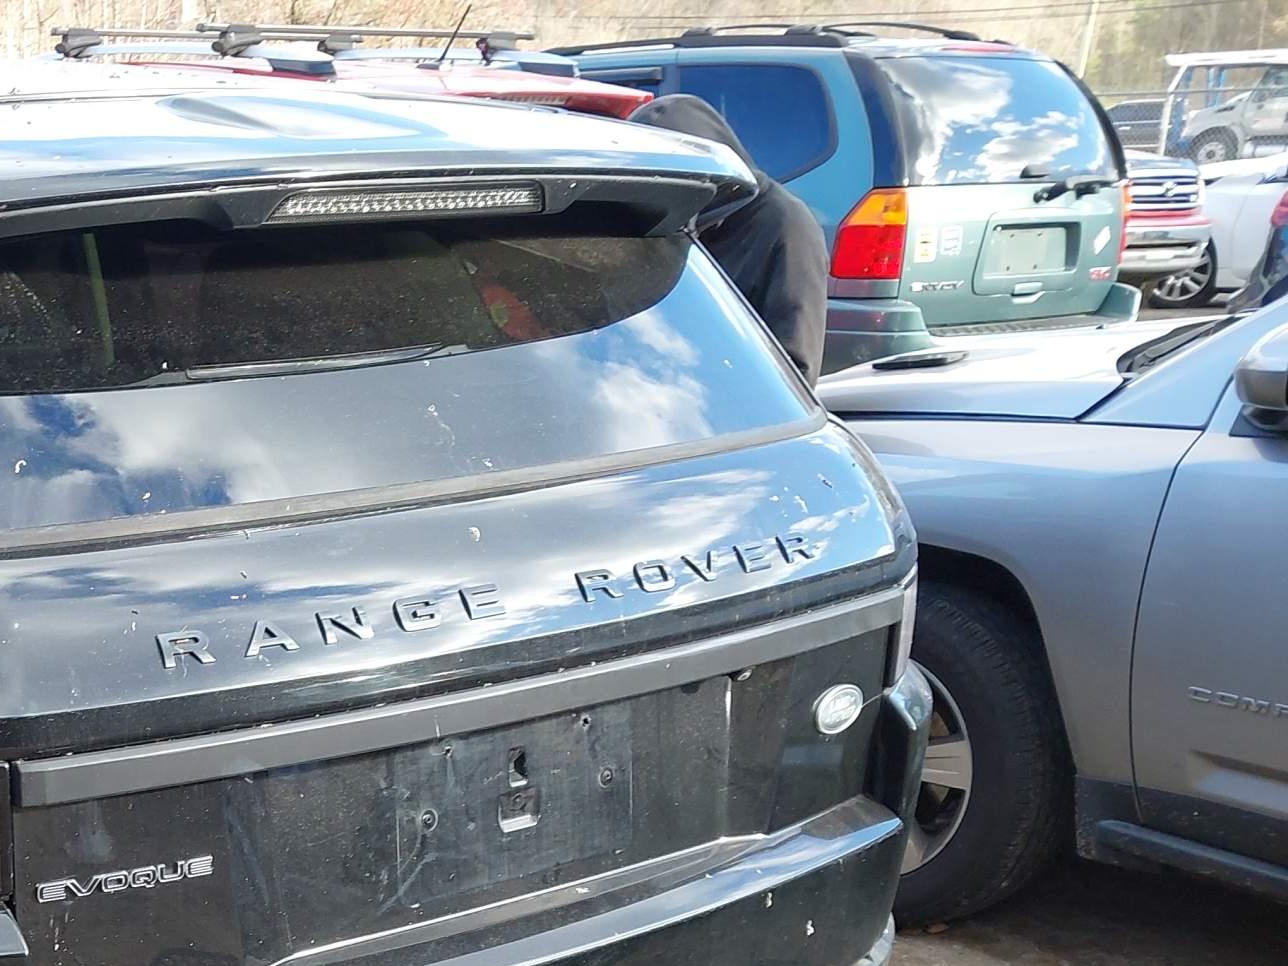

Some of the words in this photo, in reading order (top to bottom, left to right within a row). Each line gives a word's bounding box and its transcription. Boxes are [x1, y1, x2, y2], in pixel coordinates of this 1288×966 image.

[155, 583, 507, 670] RANGE
[573, 534, 815, 603] ROVER
[35, 855, 215, 904] EVOQUE
